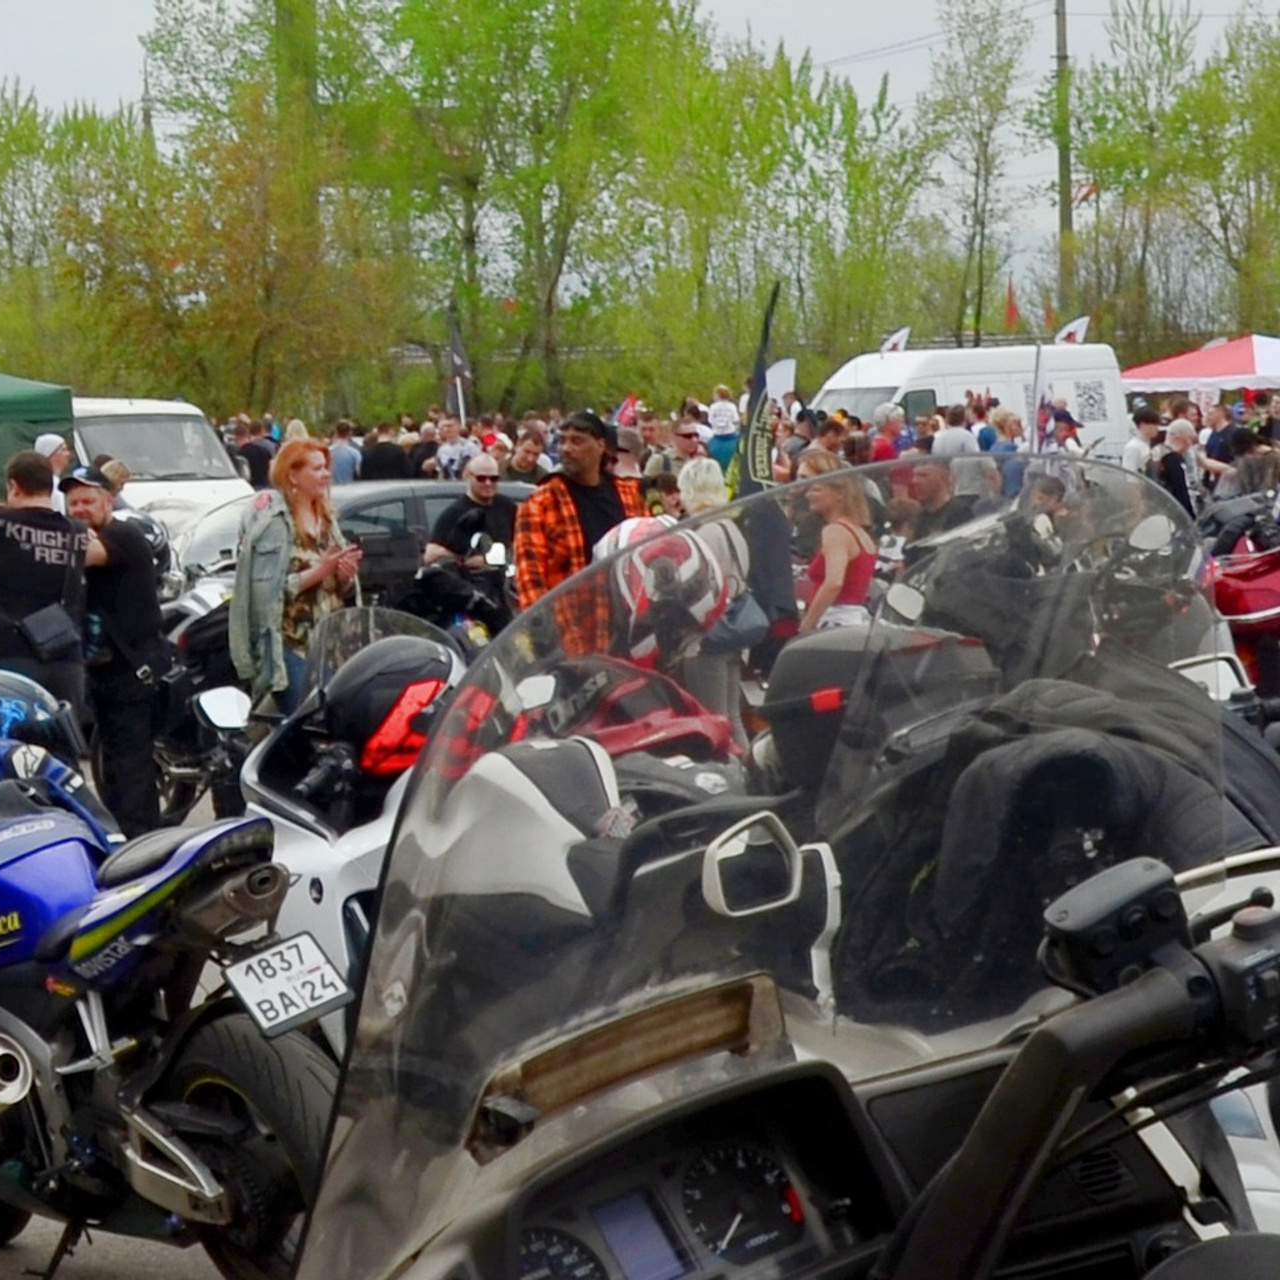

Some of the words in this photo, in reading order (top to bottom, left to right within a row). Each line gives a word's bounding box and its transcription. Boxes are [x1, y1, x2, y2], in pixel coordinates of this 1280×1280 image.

[244, 942, 305, 984] 1837
[255, 990, 300, 1023] BA
[300, 972, 339, 1003] 24
